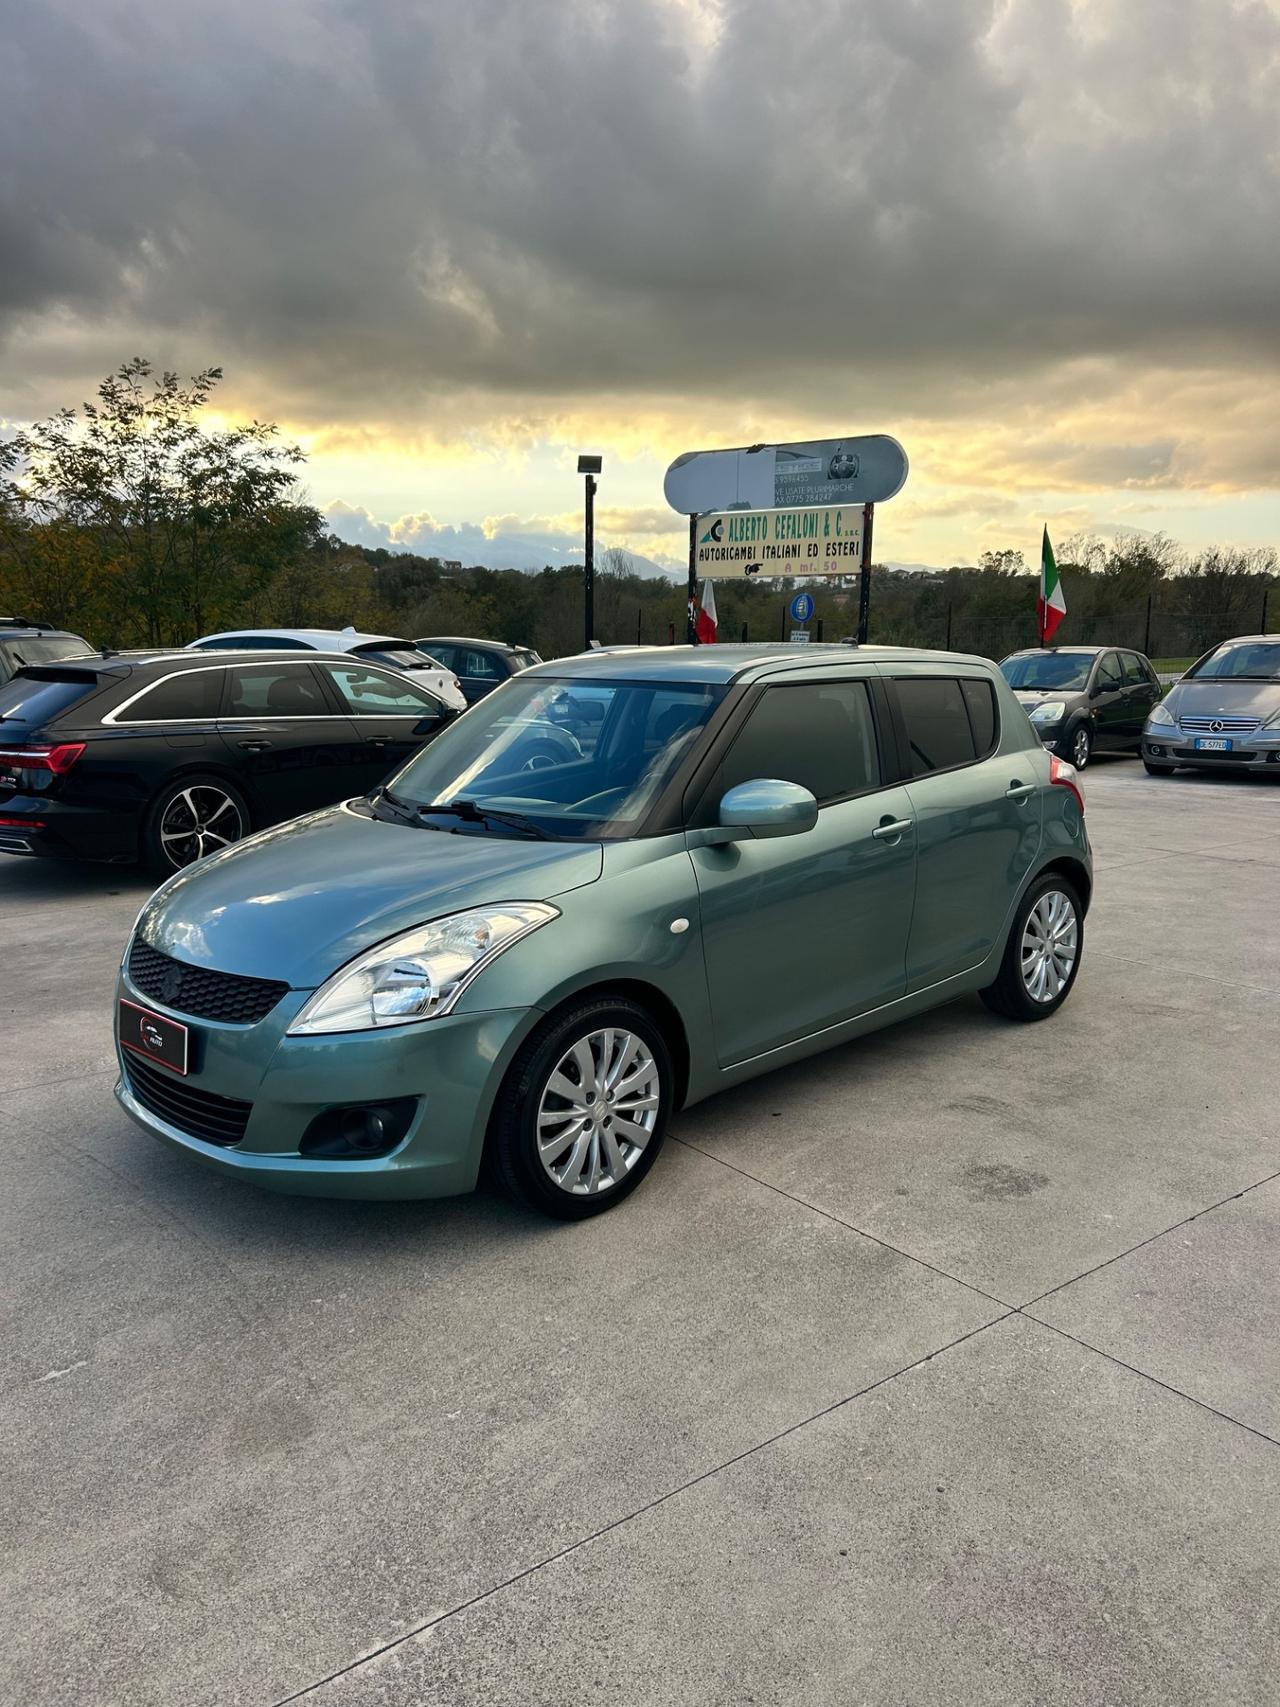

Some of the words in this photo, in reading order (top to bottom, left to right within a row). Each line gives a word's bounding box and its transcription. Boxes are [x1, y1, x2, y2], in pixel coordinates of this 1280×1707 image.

[729, 515, 768, 542] ALBERTO
[775, 512, 818, 540] CEFALONI
[824, 511, 830, 537] &
[699, 546, 756, 561] AUTORICAMBI
[762, 544, 801, 560] ITALIANI
[807, 543, 818, 557] ED
[826, 541, 859, 556] ESTERI
[784, 562, 792, 573] A
[823, 561, 837, 572] 50
